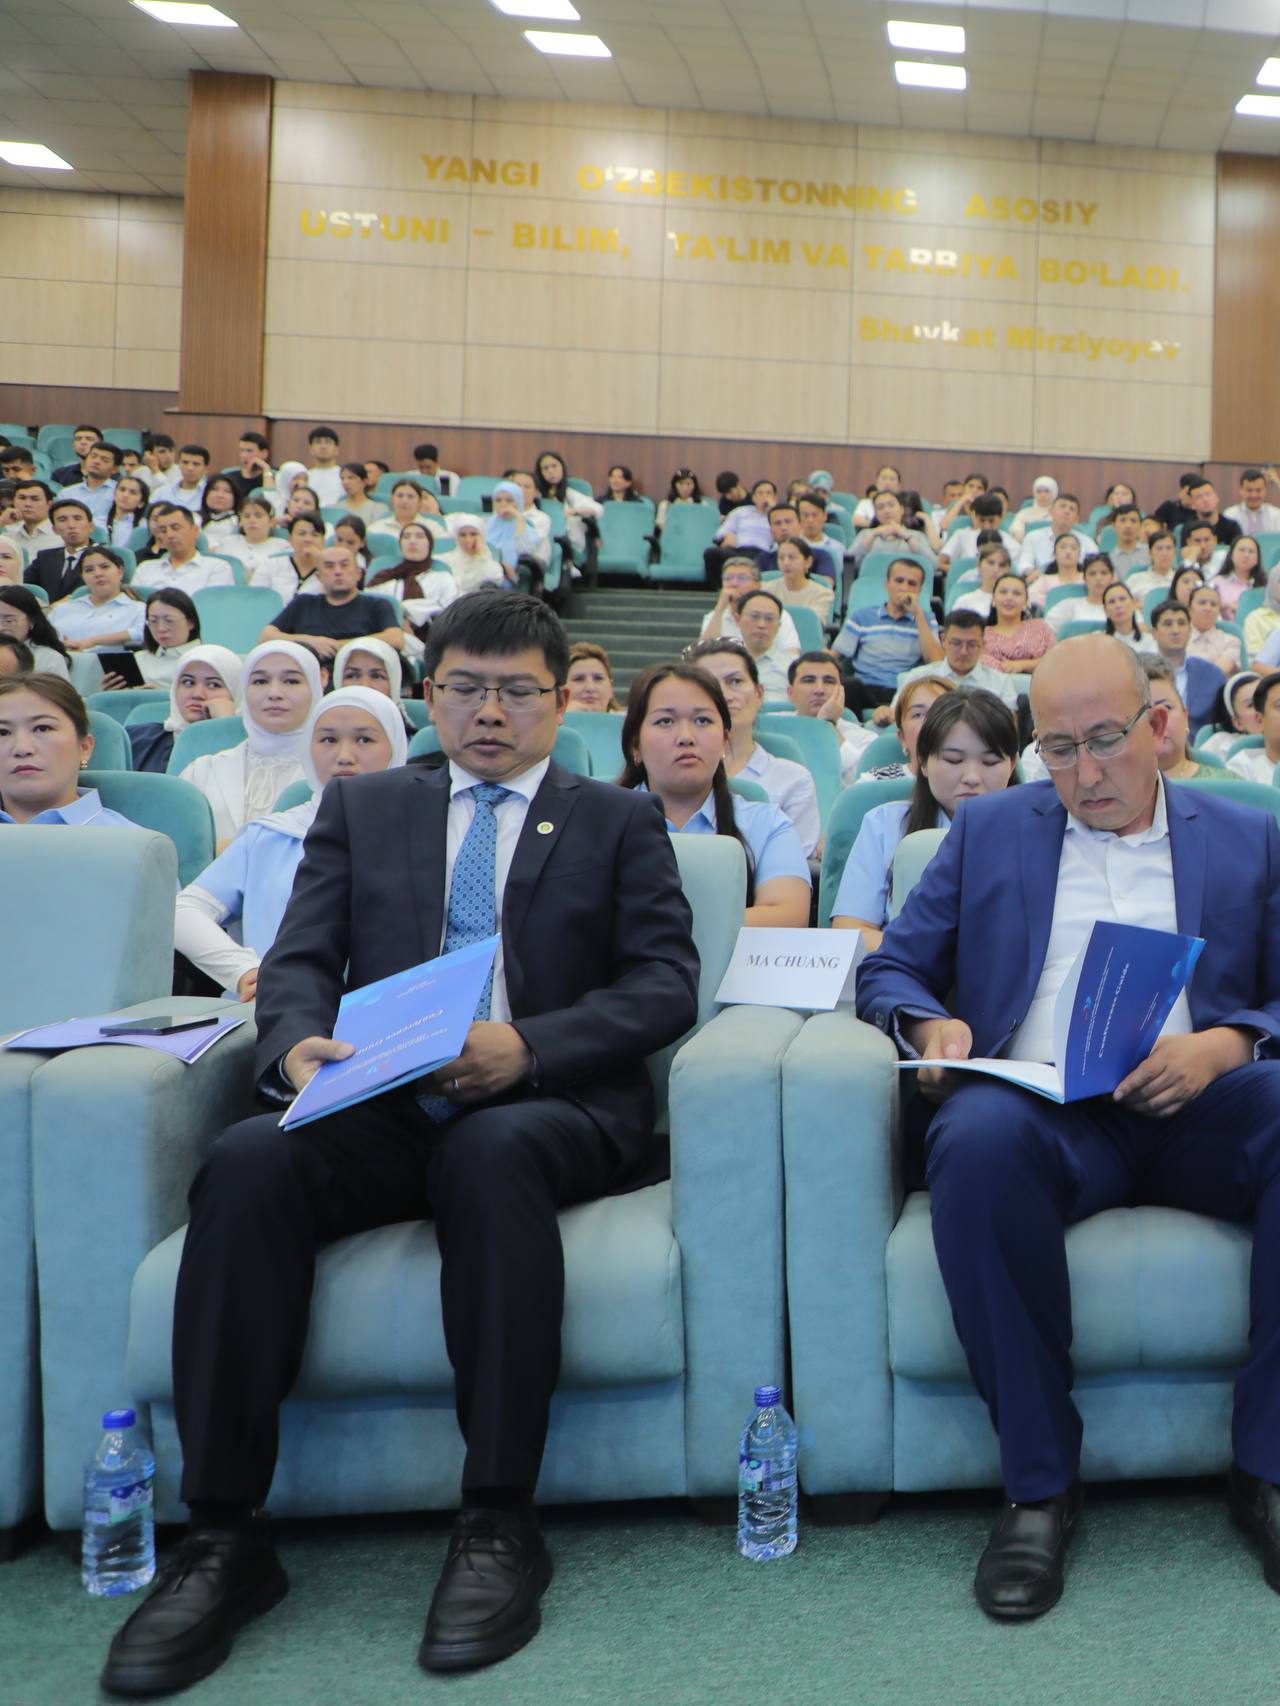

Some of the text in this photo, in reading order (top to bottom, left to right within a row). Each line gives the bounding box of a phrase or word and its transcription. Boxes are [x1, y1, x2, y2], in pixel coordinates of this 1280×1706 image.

[420, 153, 540, 188] YANGI
[963, 191, 1098, 226] ASOSIY
[300, 208, 450, 245] USTUNI
[512, 221, 630, 260] BILIM,
[801, 241, 849, 268] VA
[863, 243, 1018, 280] TARBIYA
[1007, 325, 1181, 364] Mirziyoyev
[746, 954, 841, 969] MA CHUANG
